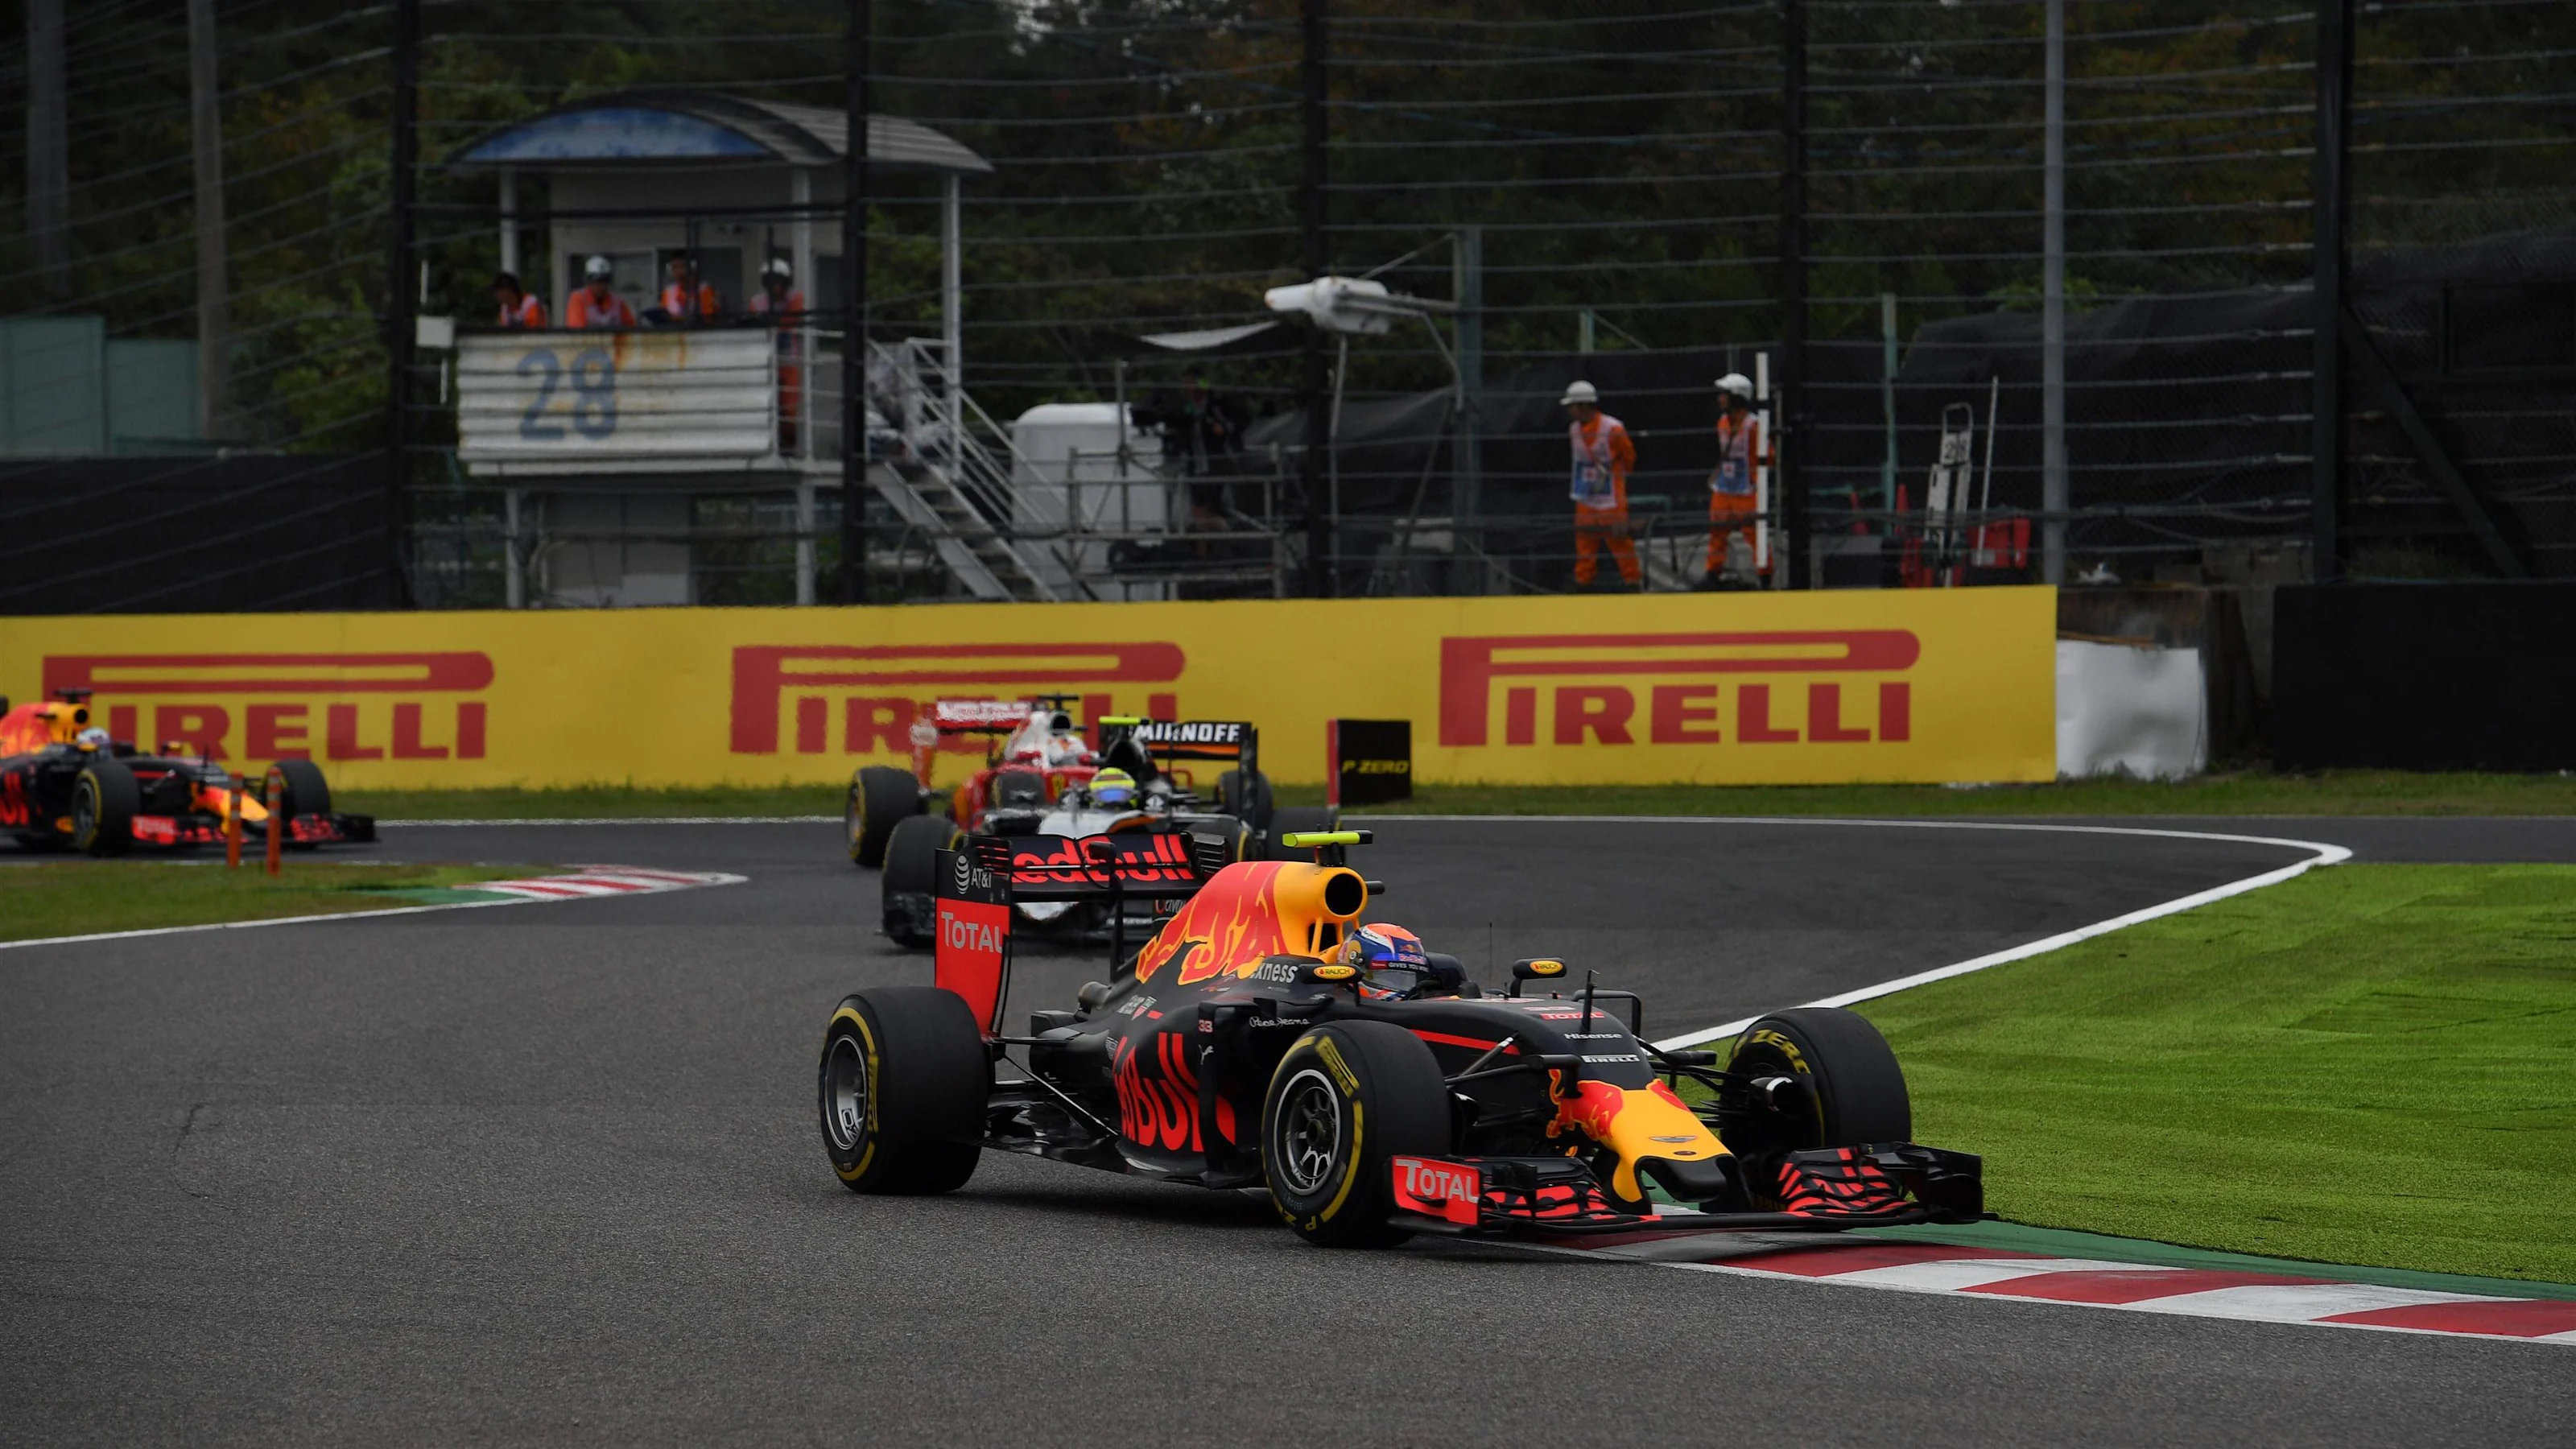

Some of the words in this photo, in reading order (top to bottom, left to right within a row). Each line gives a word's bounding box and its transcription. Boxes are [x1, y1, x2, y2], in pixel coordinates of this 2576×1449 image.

[516, 347, 617, 440] 28
[1440, 630, 1920, 746] PIRELLI
[1341, 760, 1356, 774] P
[1358, 760, 1410, 774] ZERO
[940, 910, 1003, 954] TOTAL
[1249, 962, 1298, 983] xness
[1198, 1019, 1213, 1033] 33
[1581, 1055, 1641, 1063] PIRELLI
[1395, 1158, 1480, 1203] TOTAL
